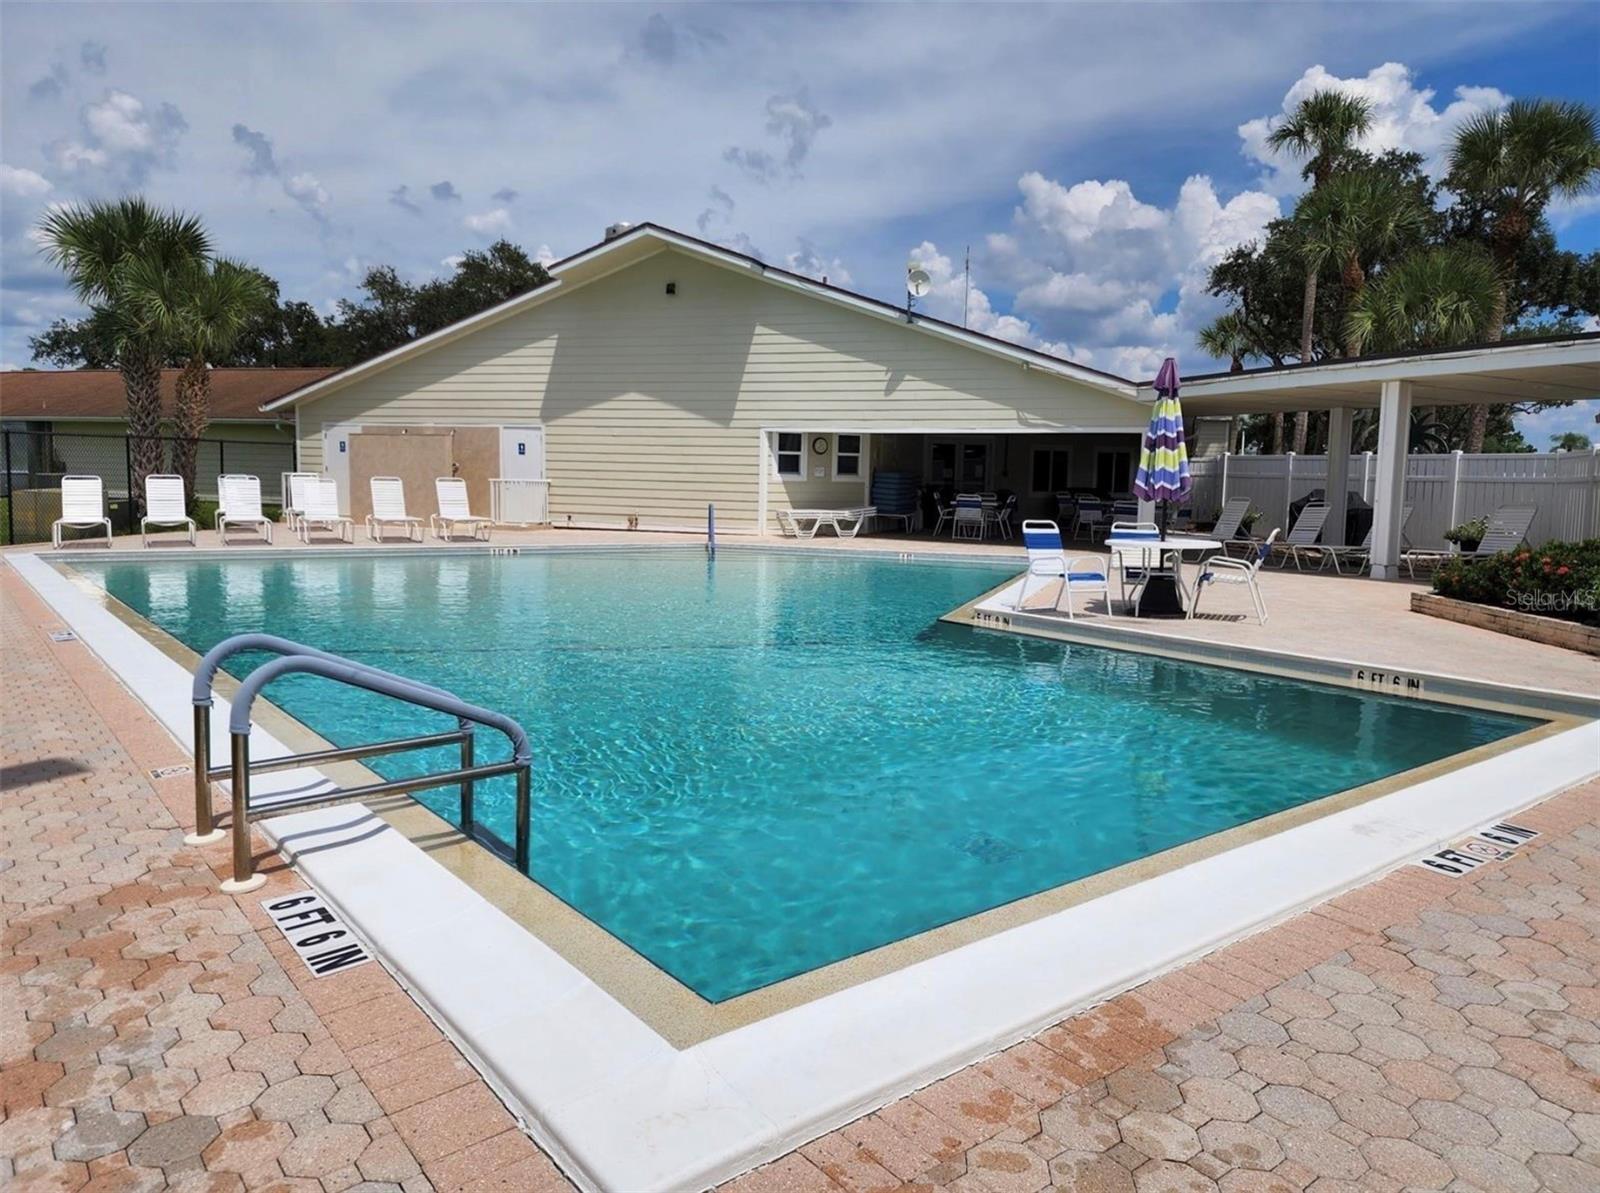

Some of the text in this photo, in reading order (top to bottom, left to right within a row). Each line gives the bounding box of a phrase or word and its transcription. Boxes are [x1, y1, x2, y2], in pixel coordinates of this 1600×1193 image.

[1371, 673, 1384, 683] FT
[1407, 678, 1420, 689] IN
[1479, 832, 1519, 845] 6
[1490, 822, 1539, 839] IN
[1421, 859, 1463, 874] 6
[1434, 849, 1485, 869] FT
[268, 896, 369, 974] 6 FT 6 IN
